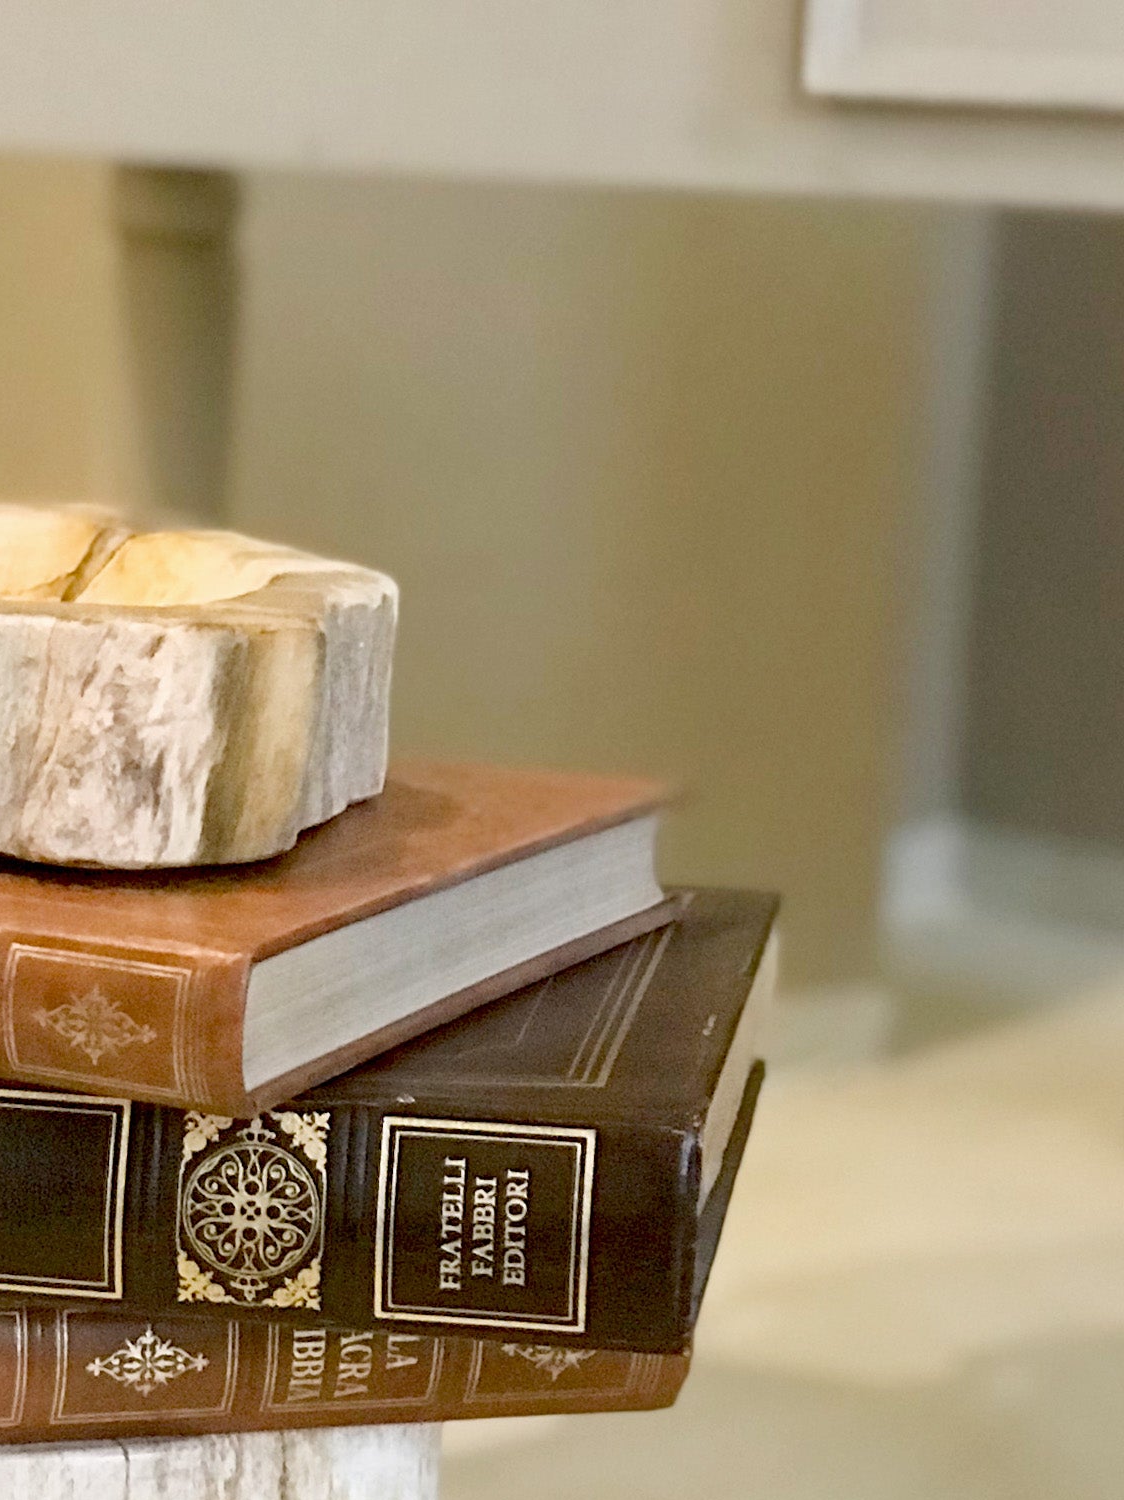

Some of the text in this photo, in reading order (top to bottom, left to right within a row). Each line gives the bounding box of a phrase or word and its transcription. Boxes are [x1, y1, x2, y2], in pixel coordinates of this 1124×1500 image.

[439, 1156, 466, 1291] FRATELLI
[471, 1176, 497, 1277] FABBRI
[503, 1168, 529, 1286] EDITORI
[287, 1329, 326, 1401] IBBIA
[333, 1331, 373, 1398] ACRA
[386, 1334, 420, 1370] LA
